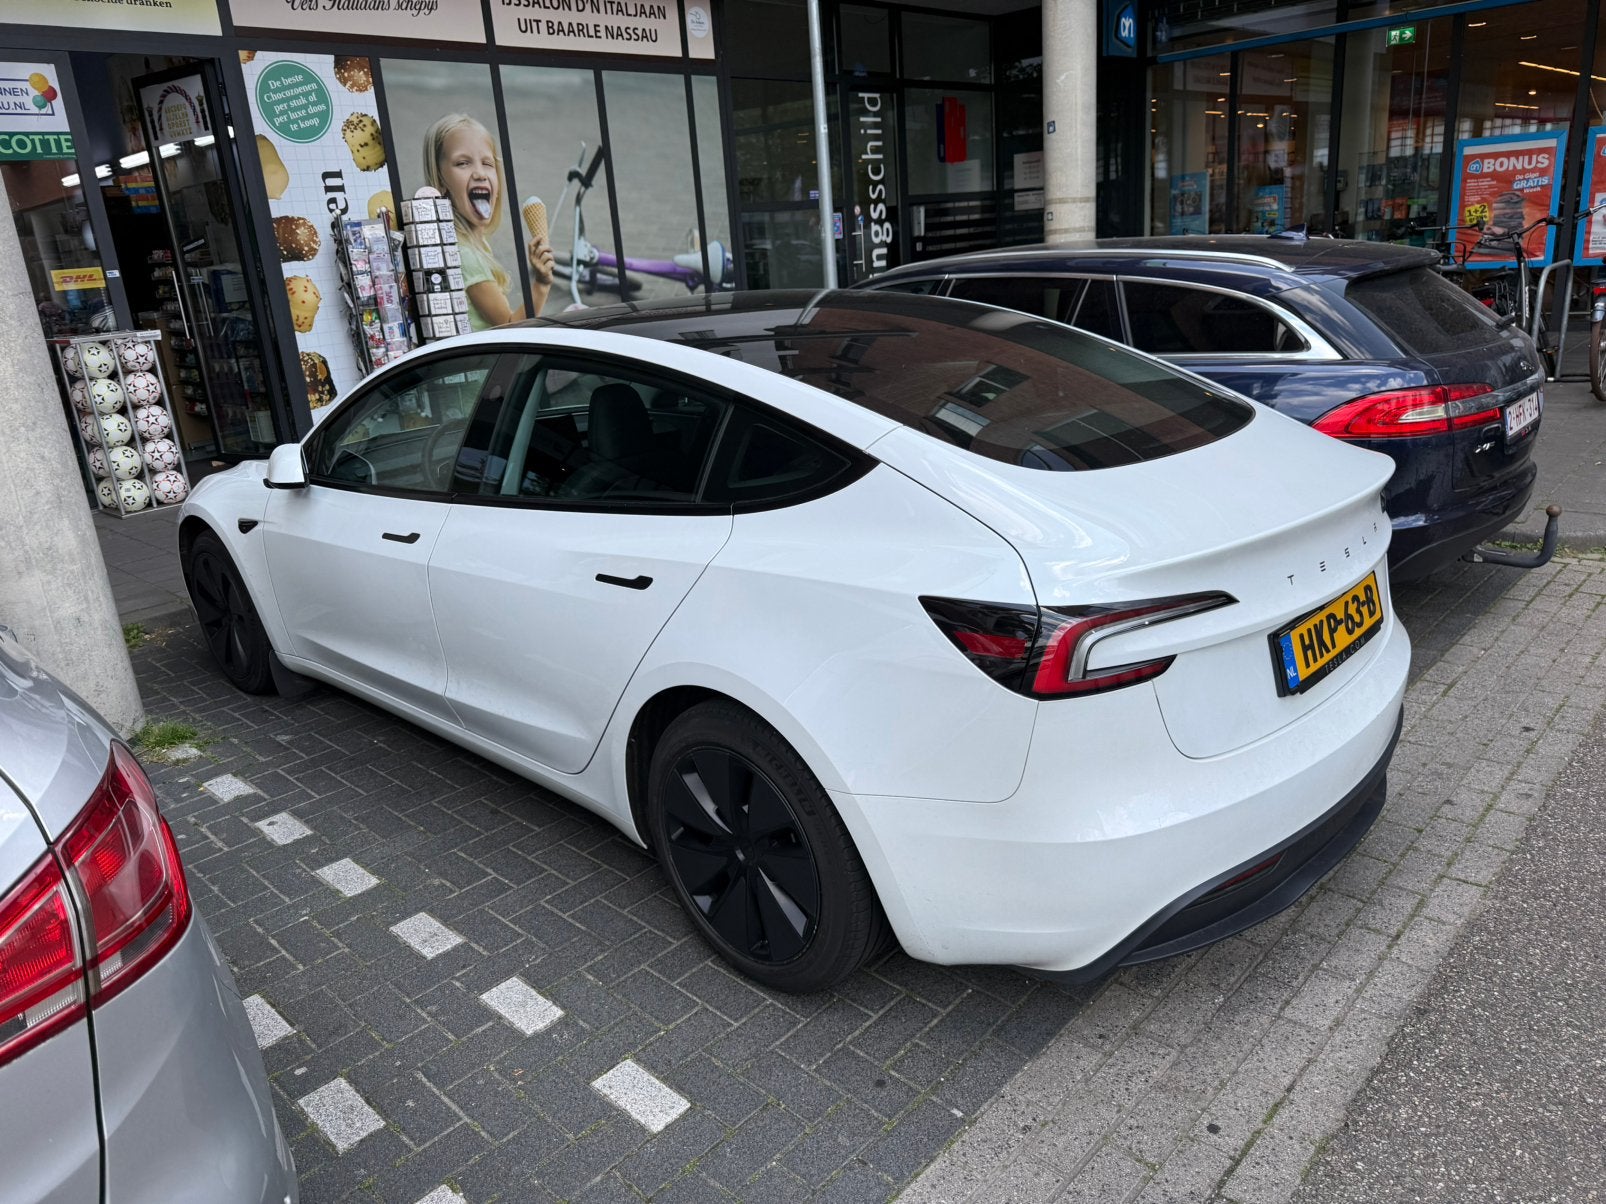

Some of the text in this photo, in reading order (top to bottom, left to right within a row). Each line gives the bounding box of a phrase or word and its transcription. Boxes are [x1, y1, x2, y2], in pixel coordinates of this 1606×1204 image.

[604, 1, 667, 20] ITALJAAN
[517, 18, 659, 43] UIT BAARLE NASSAU
[268, 74, 304, 89] De beste
[263, 82, 318, 102] Chocozoenen
[274, 91, 318, 114] per stuk of
[274, 103, 327, 126] per luxe doos
[290, 117, 320, 131] te koop
[1482, 153, 1550, 173] BONUS
[1513, 176, 1549, 190] GRATIS
[1467, 204, 1488, 218] 1+2
[60, 273, 97, 284] DHL
[1299, 583, 1378, 669] HKP-63-B
[1325, 637, 1367, 674] TESLA.COM
[1286, 667, 1297, 680] NL
